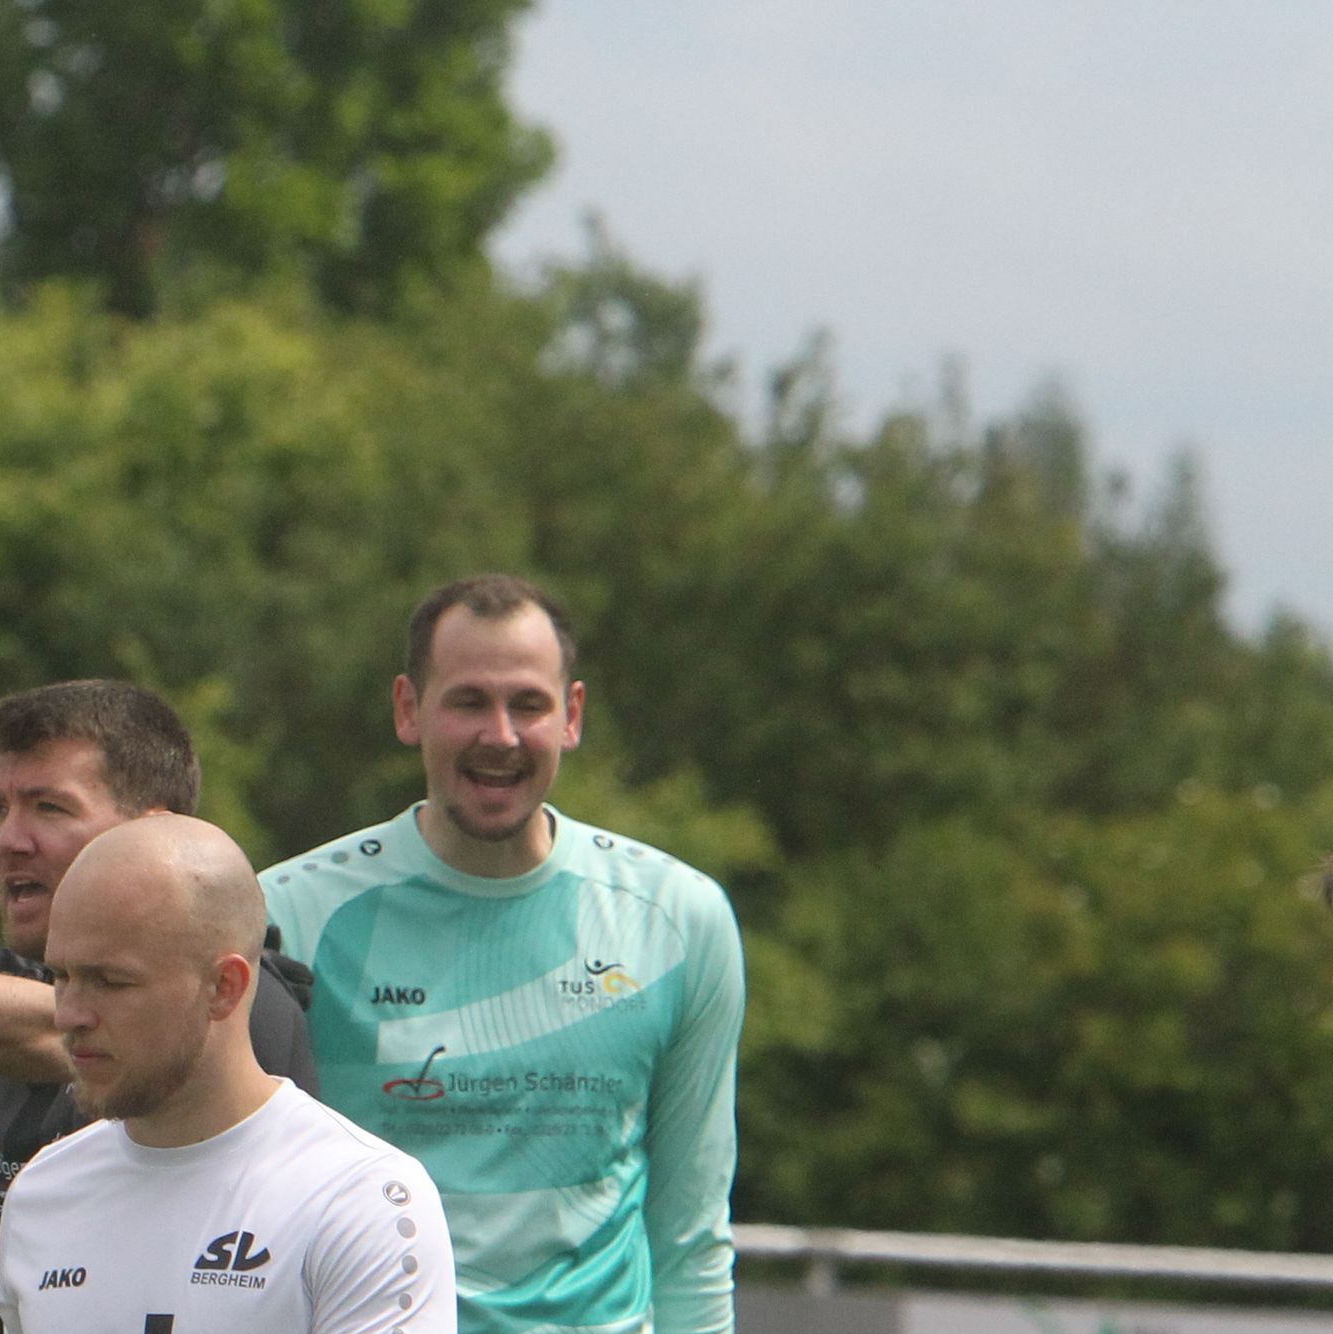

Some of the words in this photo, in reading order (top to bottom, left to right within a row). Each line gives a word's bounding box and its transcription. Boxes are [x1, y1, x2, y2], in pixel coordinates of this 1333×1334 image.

[371, 986, 426, 1005] JAKO
[447, 1073, 518, 1096] Jürgen
[524, 1072, 623, 1095] Schänzler
[39, 1267, 87, 1291] JAKO
[190, 1271, 266, 1290] BERGHEIM
